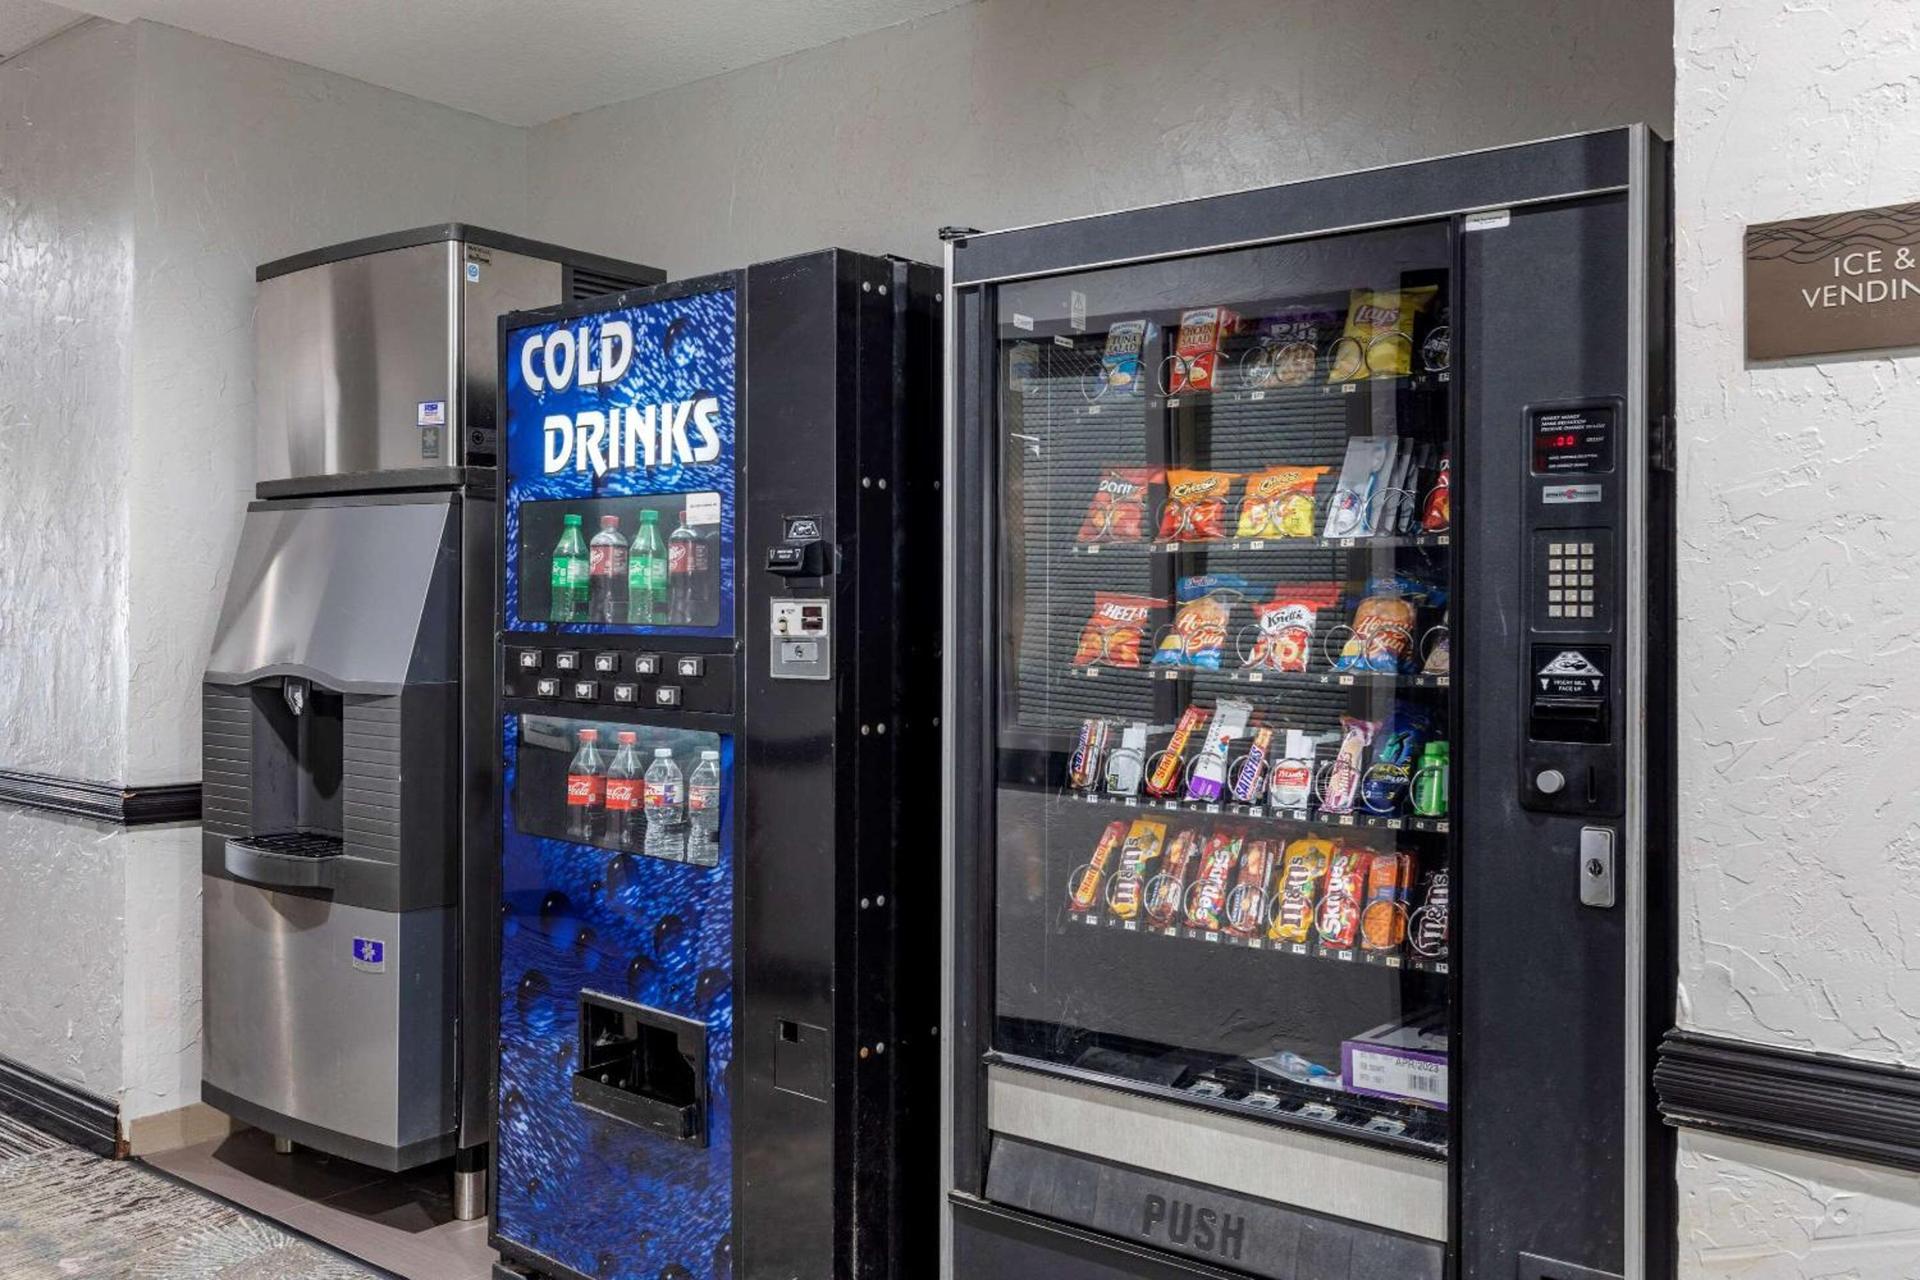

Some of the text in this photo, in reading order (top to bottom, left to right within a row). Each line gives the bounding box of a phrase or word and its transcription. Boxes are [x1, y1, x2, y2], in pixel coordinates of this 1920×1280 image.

[1834, 247, 1916, 277] ICE &
[521, 319, 634, 392] COLD
[544, 397, 722, 478] DRINKS
[1141, 1193, 1246, 1260] PUSH
